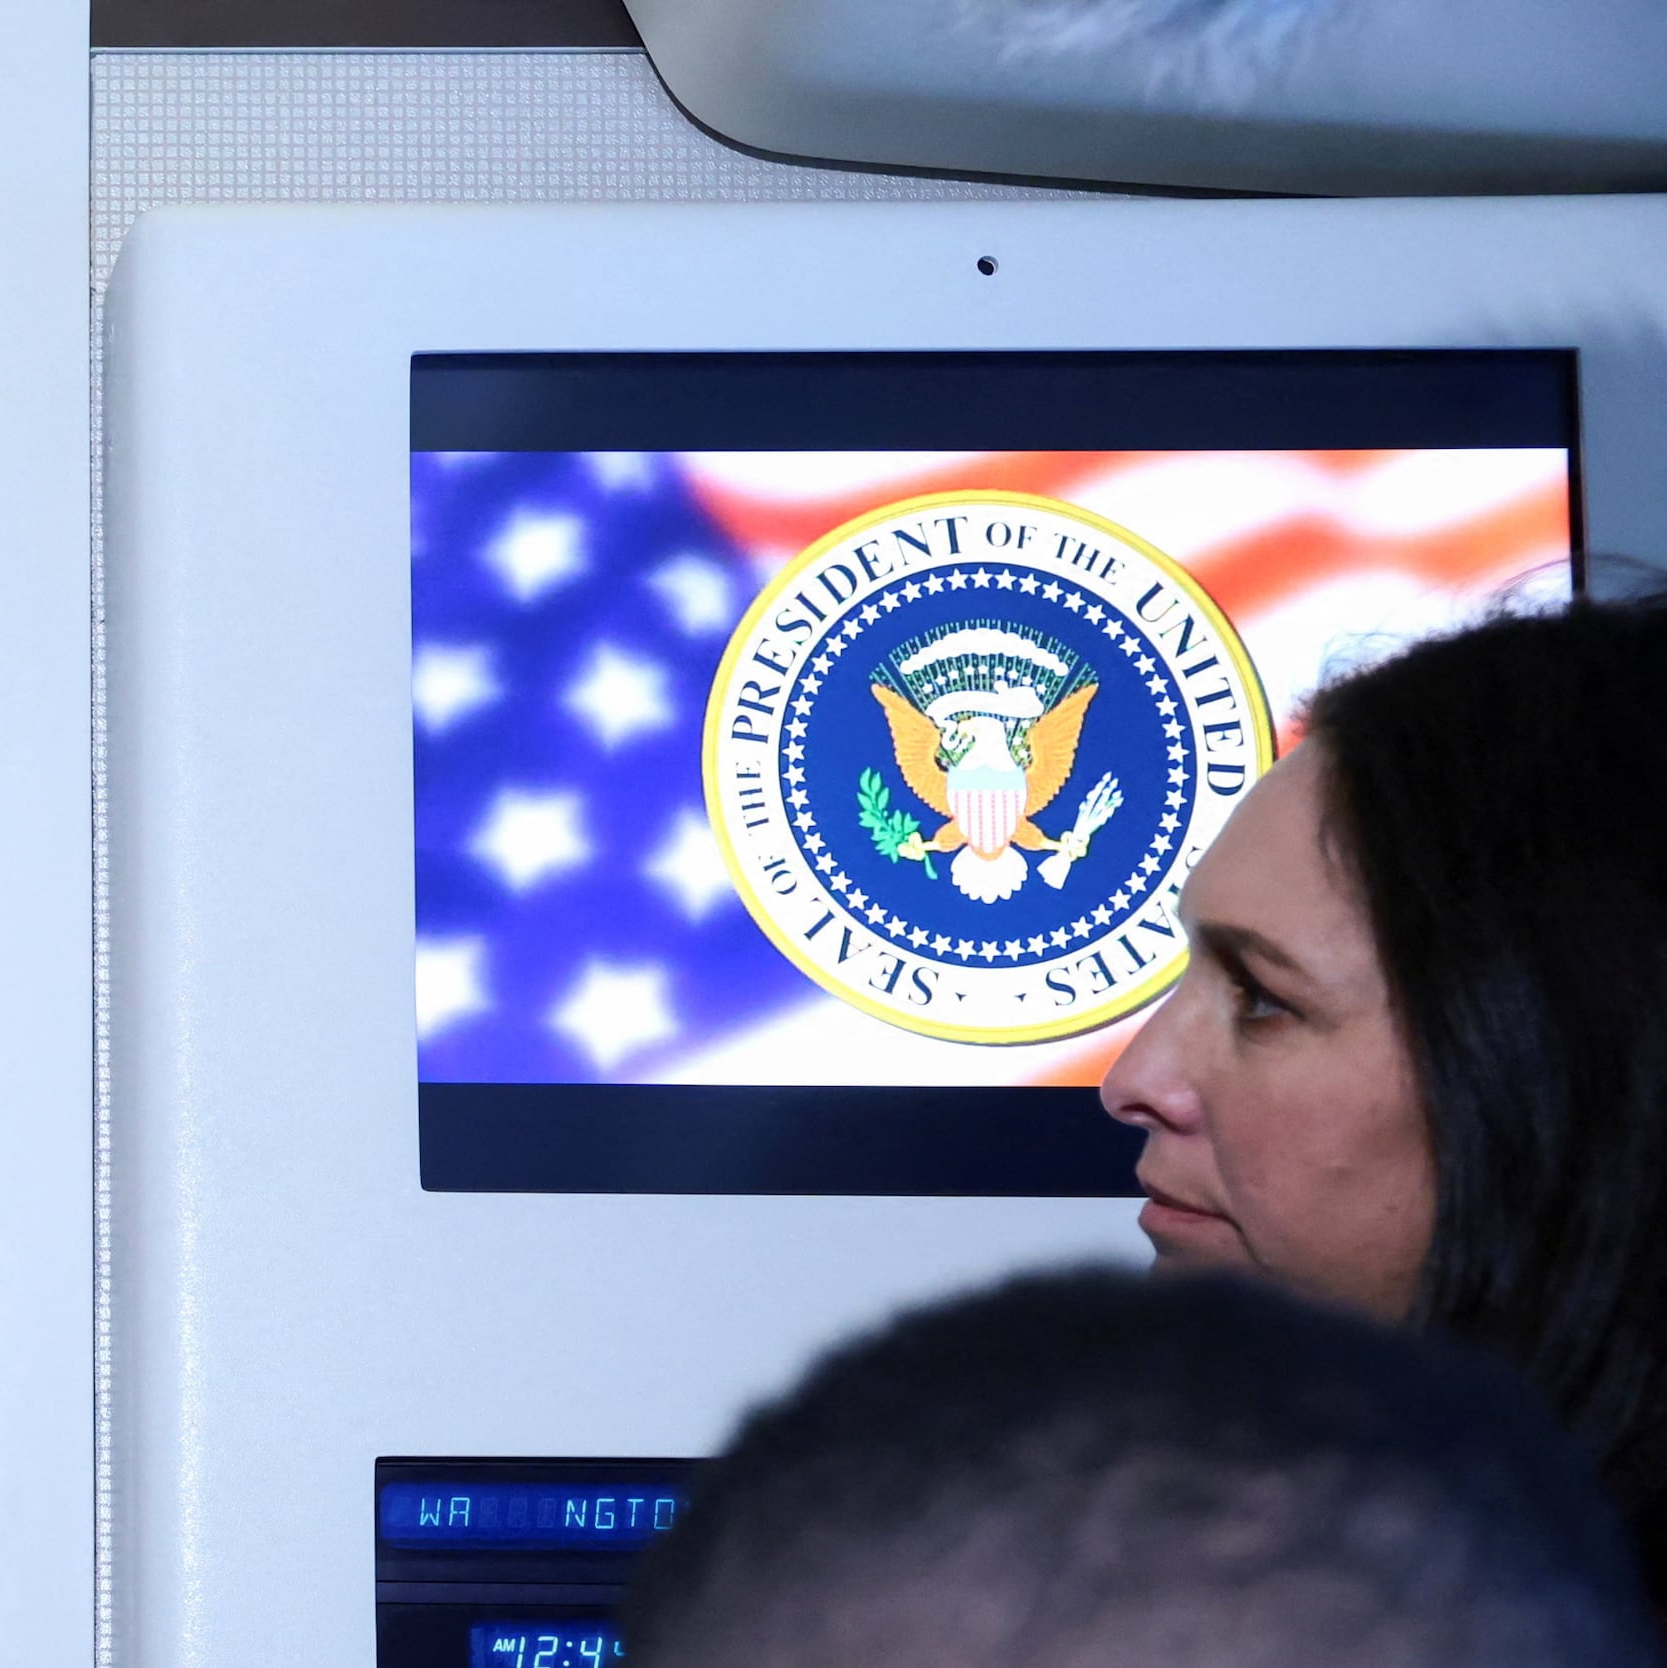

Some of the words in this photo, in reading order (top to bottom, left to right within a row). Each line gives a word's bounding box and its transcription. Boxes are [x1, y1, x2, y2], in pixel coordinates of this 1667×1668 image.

[984, 520, 1039, 549] OF
[1053, 531, 1127, 587] THE
[731, 515, 968, 745] PRESIDENT
[1135, 580, 1247, 797] UNITED
[735, 759, 770, 837] THE
[757, 854, 798, 896] OF
[803, 896, 940, 1006] SEAL
